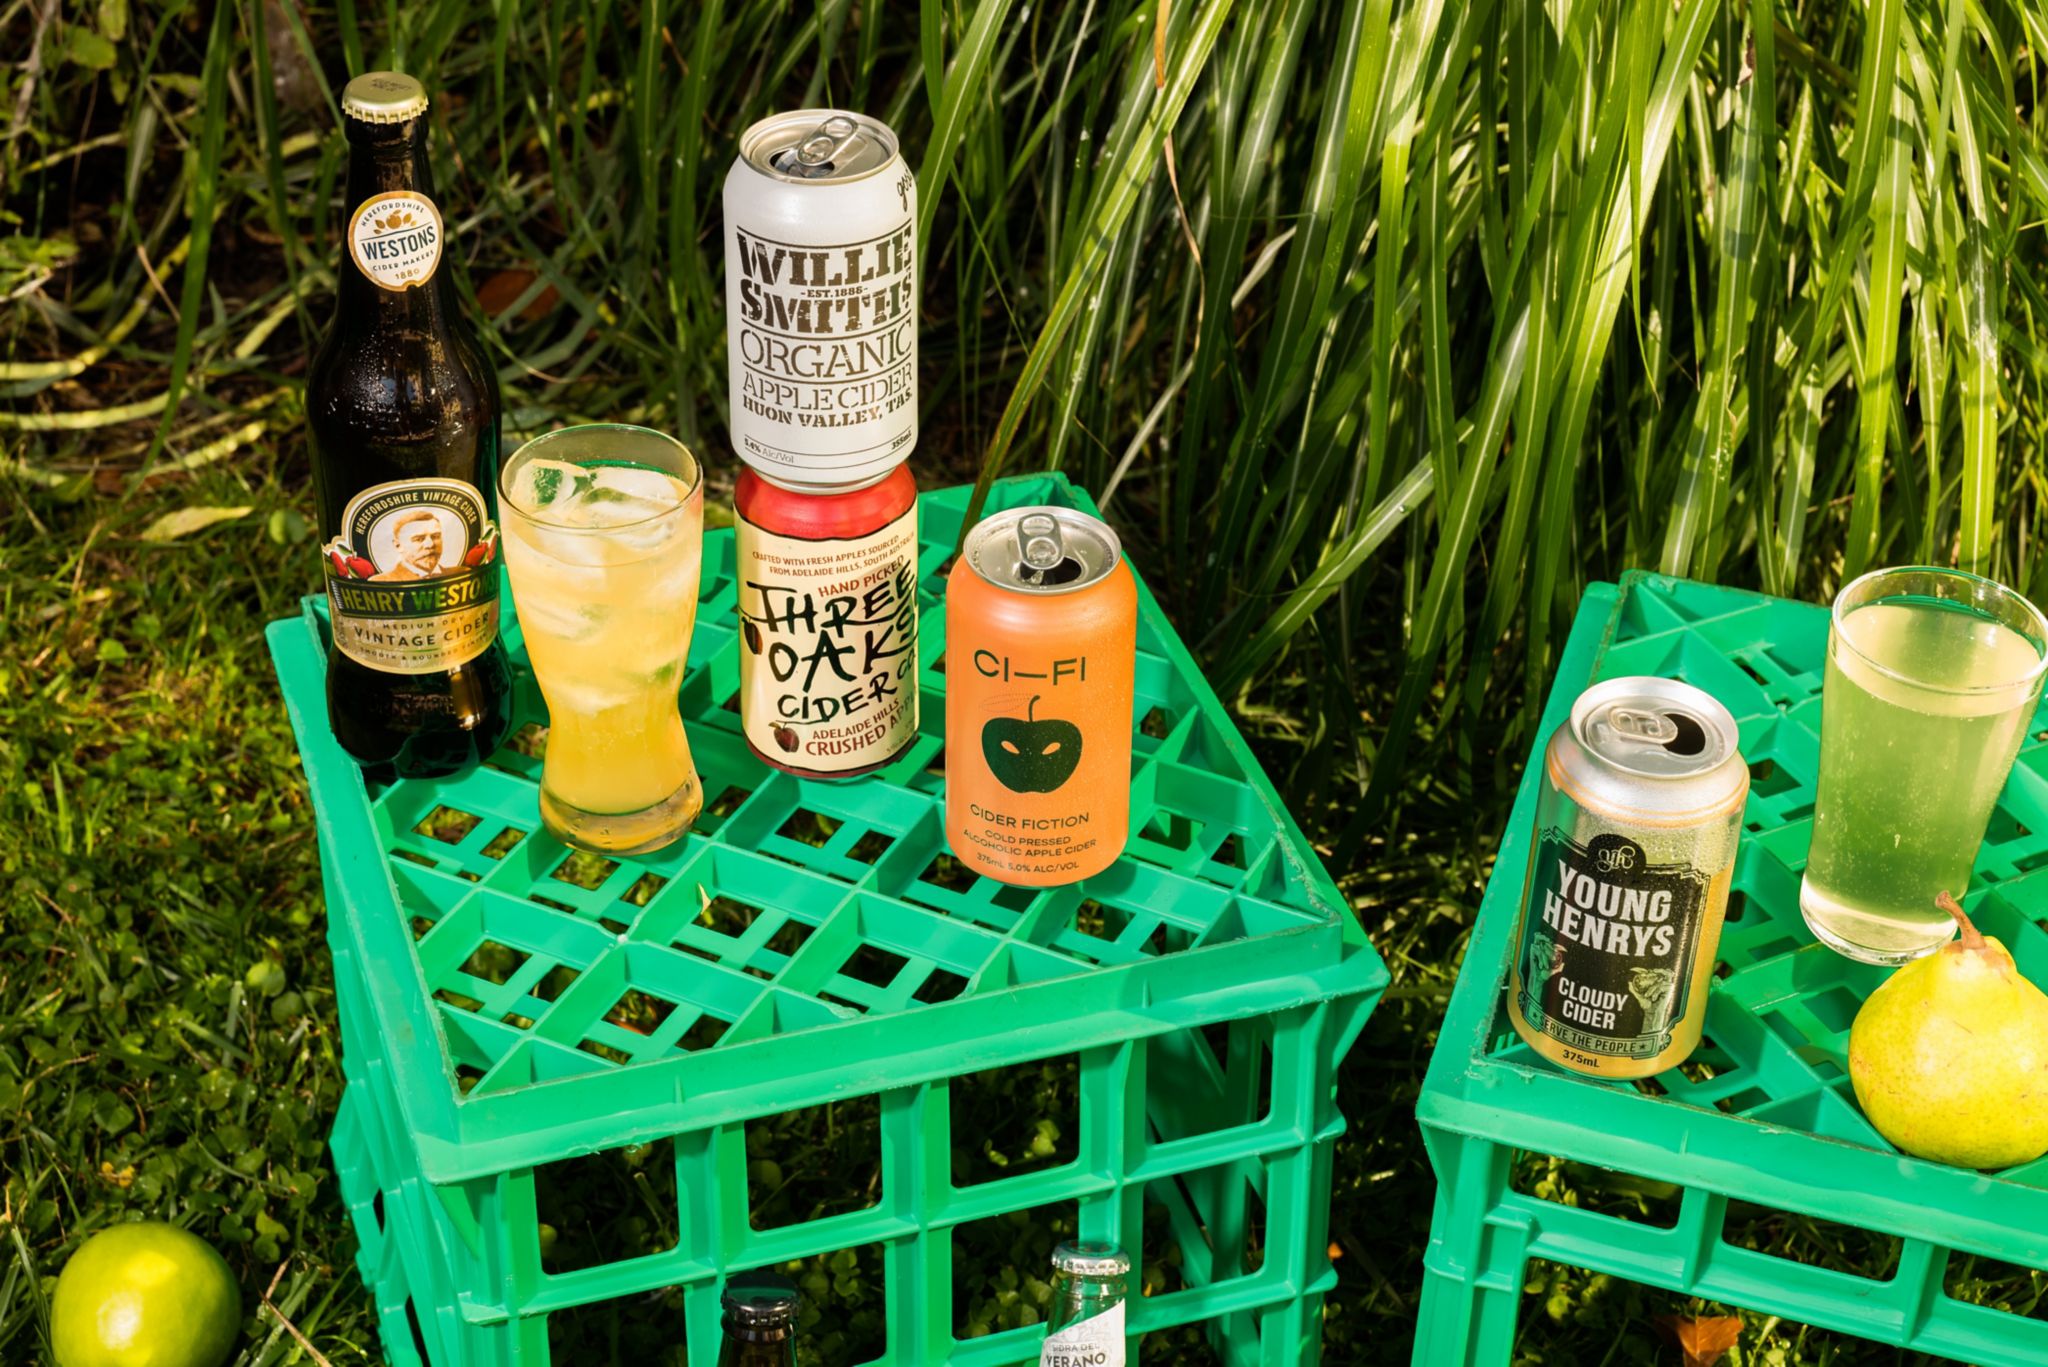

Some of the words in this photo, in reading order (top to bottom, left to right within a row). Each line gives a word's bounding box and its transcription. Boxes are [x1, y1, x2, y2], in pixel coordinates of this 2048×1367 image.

[361, 202, 424, 227] HEREFORDSHIRE
[362, 226, 436, 260] WESTONS
[736, 224, 911, 287] WILLIE
[373, 263, 399, 272] CIDER
[403, 250, 434, 267] MAKERS
[395, 268, 420, 280] 1880
[741, 318, 911, 378] ORGANIC
[743, 370, 833, 411] APPLE
[838, 362, 912, 408] CIDER
[742, 394, 793, 425] HUON
[798, 404, 884, 428] VALLEY,
[762, 447, 794, 464] Alc/Vol
[354, 491, 419, 536] HEREFORDSHIRE
[423, 491, 462, 507] VINTAGE
[461, 500, 478, 525] CIDER
[769, 566, 791, 576] FROM
[792, 568, 834, 577] ADELAIDE
[836, 563, 862, 574] HILLS,
[863, 554, 888, 568] SOUTH
[783, 555, 804, 566] WITH
[806, 555, 833, 566] FRESH
[835, 550, 867, 563] APPLES
[868, 534, 900, 556] SOURCED
[818, 579, 859, 598] HAND
[864, 554, 904, 588] PICKED
[341, 586, 405, 613] HENRY
[746, 559, 916, 638] THREE
[354, 625, 435, 648] VINTAGE
[443, 612, 489, 642] CIDER
[383, 621, 435, 630] MEDIUM
[442, 615, 465, 627] DRY
[777, 671, 898, 722] CIDER
[812, 717, 872, 740] ADELAIDE
[873, 697, 899, 724] HILLS
[805, 724, 887, 756] CRUSHED
[970, 803, 1017, 828] CIDER
[1021, 811, 1089, 831] FICTION
[963, 828, 1022, 857] ALCOHOLIC
[1024, 848, 1062, 858] APPLE
[1064, 838, 1097, 855] CIDER
[984, 829, 1016, 844] COLD
[1018, 835, 1072, 847] PRESSED
[1007, 863, 1031, 873] 5.0%
[1033, 861, 1079, 874] ALC/VOL
[1557, 858, 1673, 923] YOUNG
[1542, 887, 1675, 957] HENRYS
[1557, 976, 1628, 1013] CLOUDY
[1562, 1000, 1616, 1031] CIDER
[1539, 1014, 1568, 1039] SERVE
[1571, 1033, 1592, 1048] THE
[1595, 1040, 1637, 1053] PEOPLE
[1562, 1049, 1600, 1068] 375mL
[1046, 1352, 1106, 1367] VERANO
